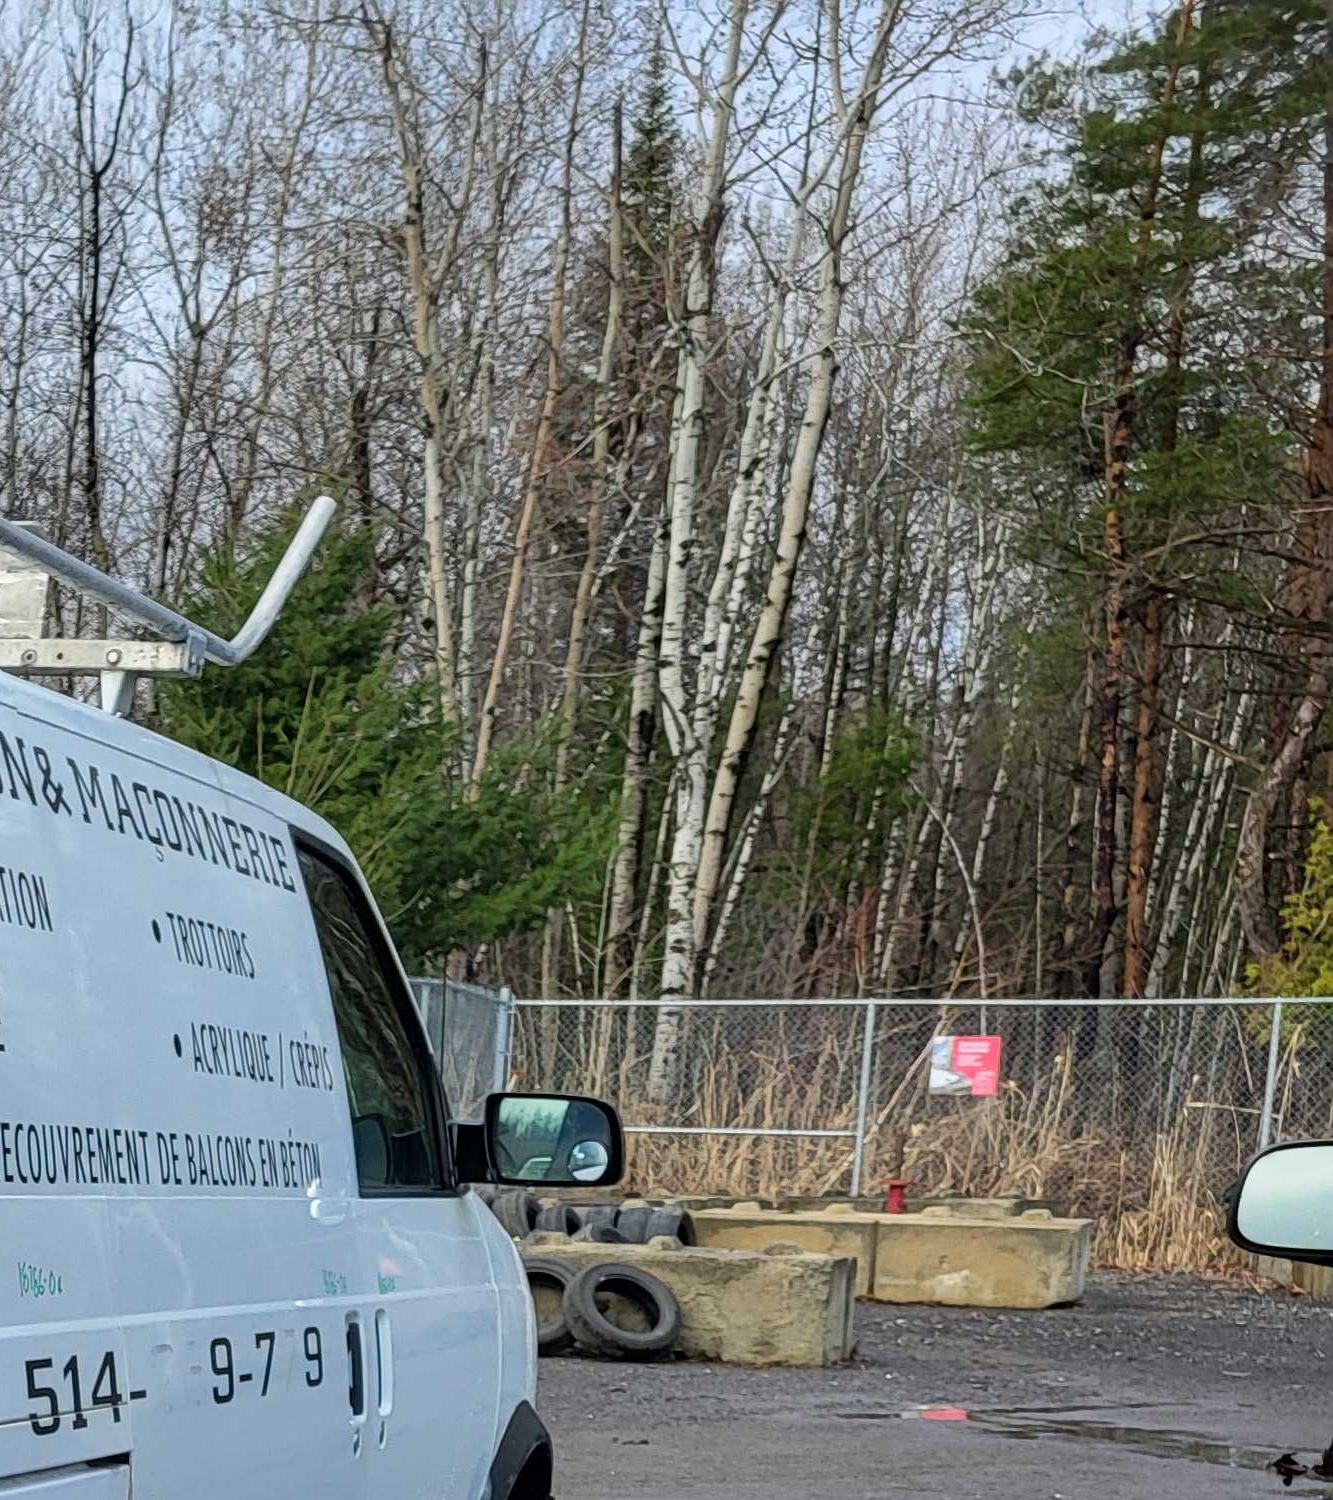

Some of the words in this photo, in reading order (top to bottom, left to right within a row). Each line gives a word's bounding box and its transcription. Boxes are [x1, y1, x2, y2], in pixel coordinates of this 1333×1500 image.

[33, 745, 71, 817] &
[66, 756, 297, 894] MAÇONNERIE
[165, 911, 255, 980] TROTTOIRS
[190, 1022, 275, 1084] ACRYLIQUE
[289, 1030, 332, 1091] CRÉPIS
[155, 1131, 180, 1186] DE
[184, 1132, 256, 1187] BALCONS
[259, 1137, 278, 1187] EN
[281, 1128, 322, 1189] BÉTON
